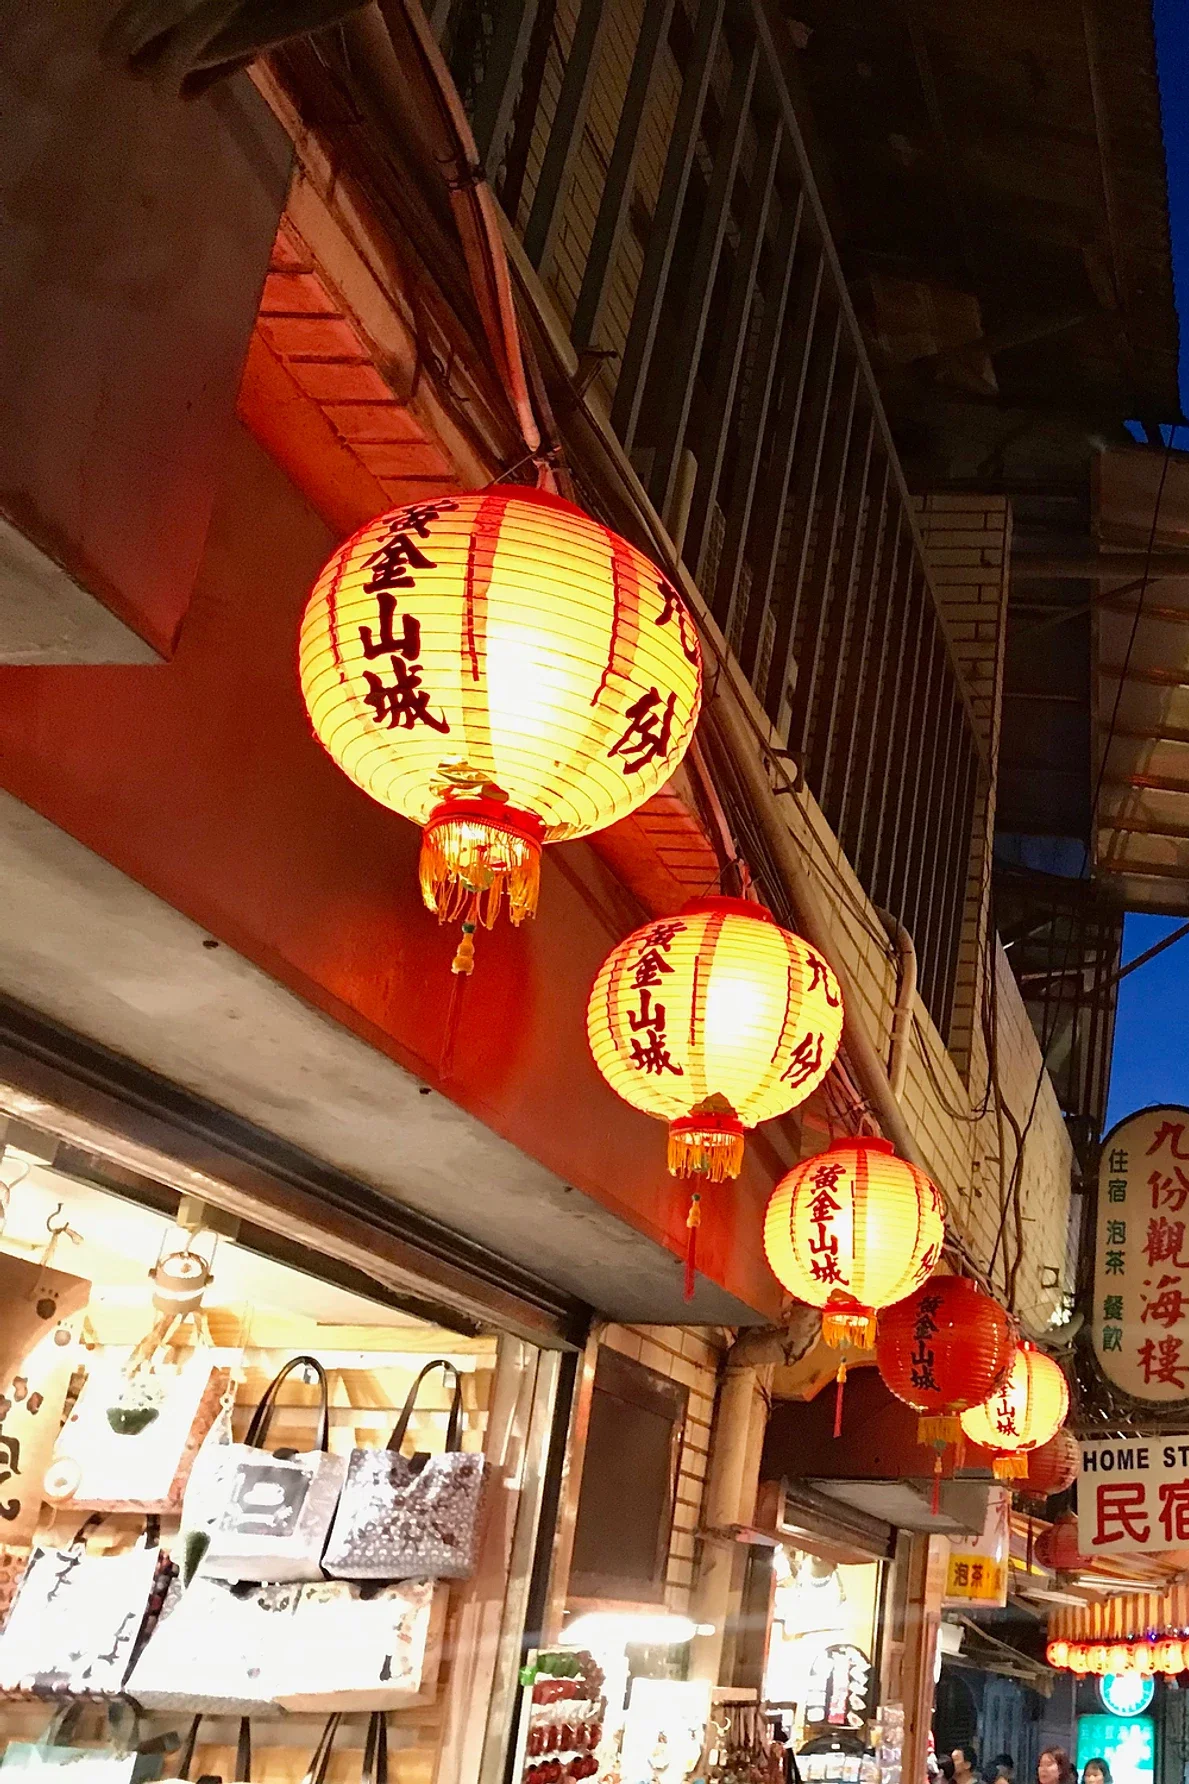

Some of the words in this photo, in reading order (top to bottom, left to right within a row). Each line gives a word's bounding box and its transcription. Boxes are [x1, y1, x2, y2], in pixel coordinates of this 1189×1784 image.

[1107, 1148, 1129, 1204] 住宿
[1104, 1219, 1127, 1276] 泡茶
[1083, 1447, 1150, 1472] HOME
